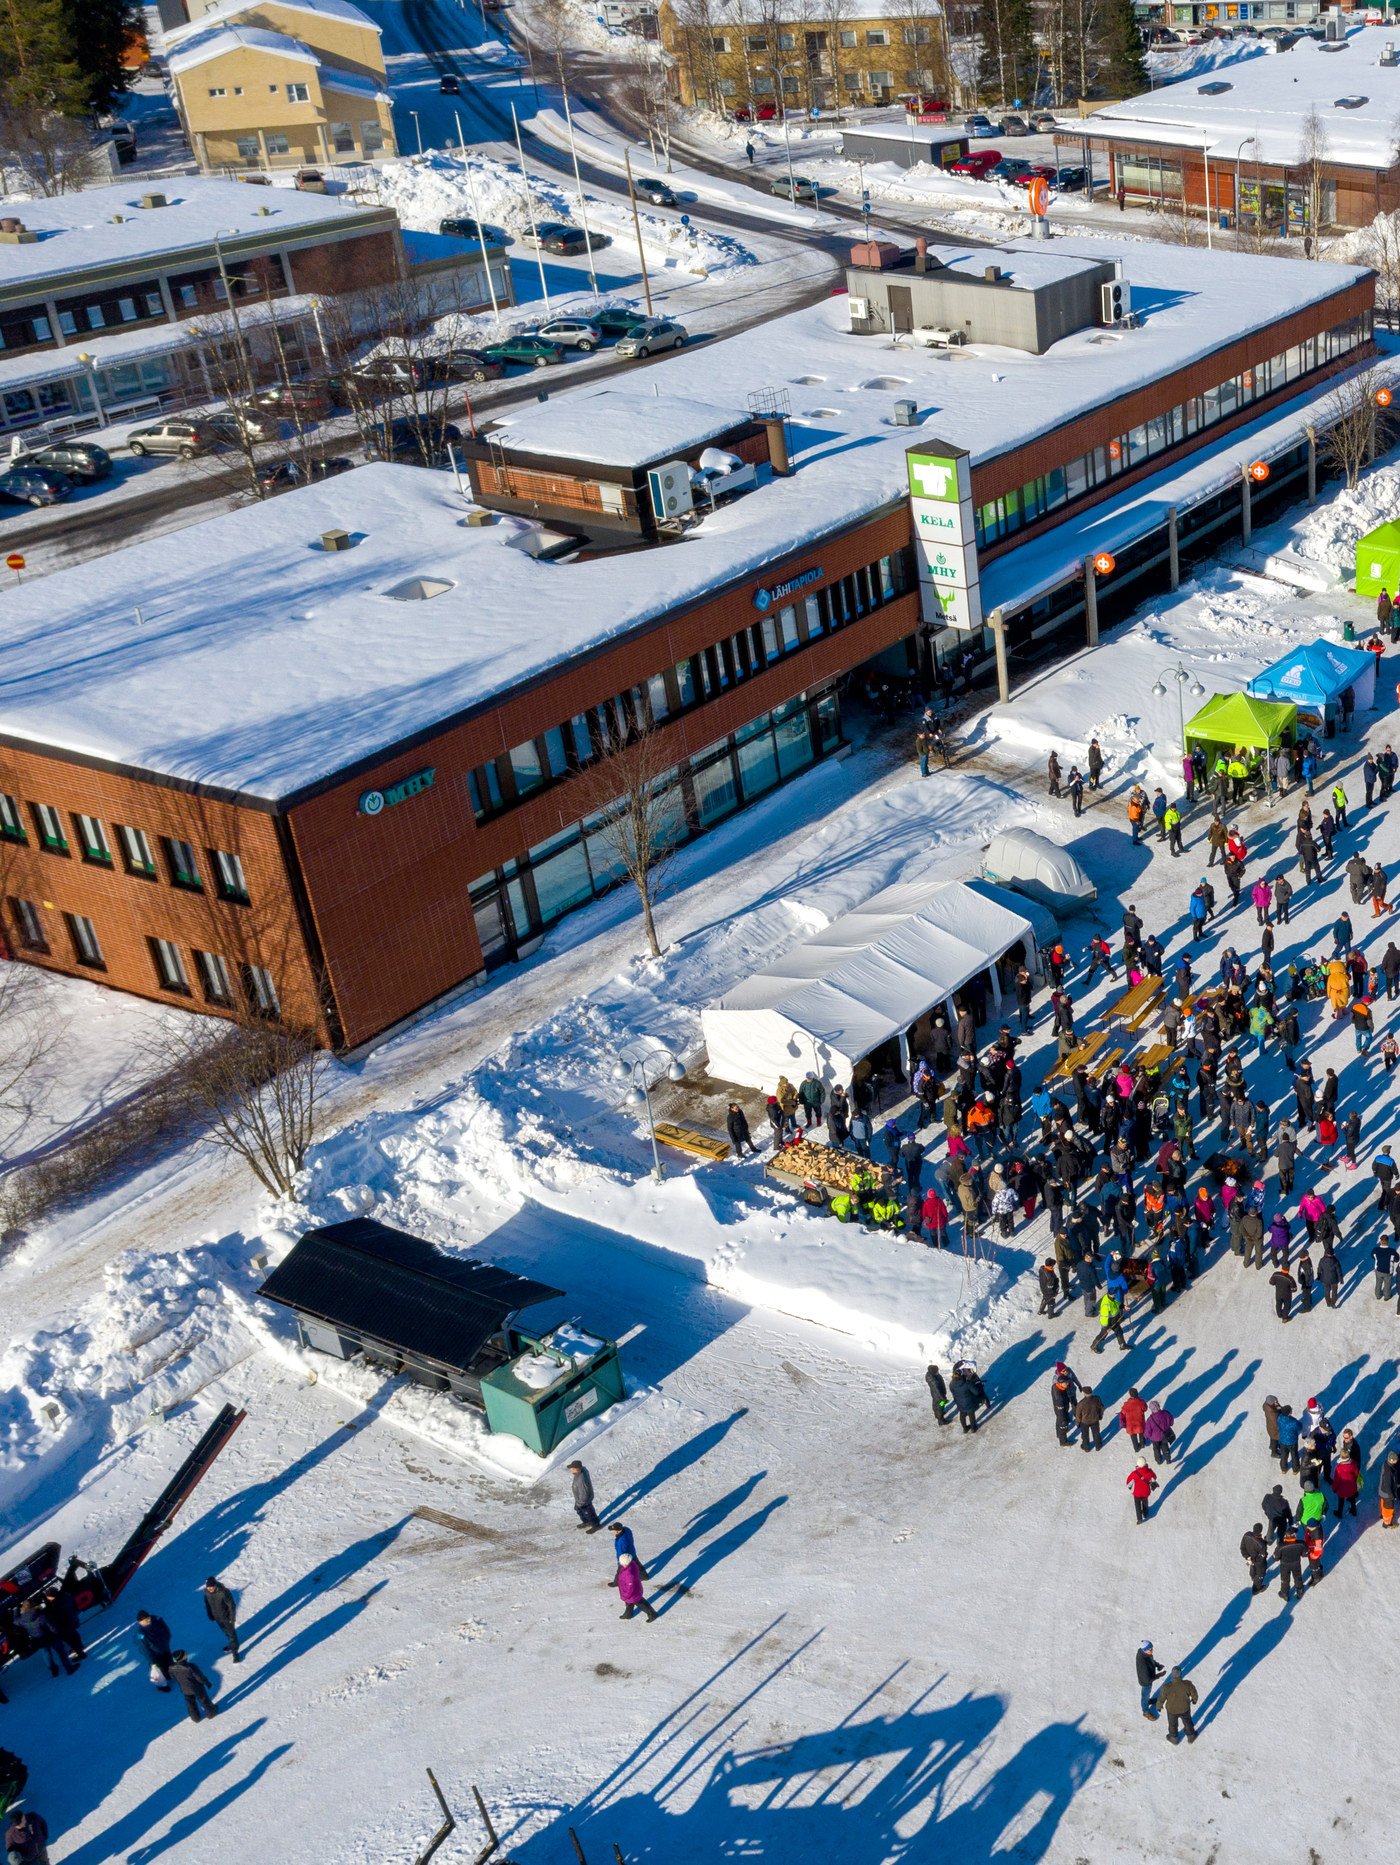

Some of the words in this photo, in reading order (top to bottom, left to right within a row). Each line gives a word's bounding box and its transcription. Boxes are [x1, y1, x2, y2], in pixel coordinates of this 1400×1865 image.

[920, 514, 955, 529] KELA
[927, 564, 957, 579] MHY
[771, 566, 824, 602] LÄHITAPIOLA
[935, 611, 958, 623] Metsä
[384, 767, 436, 806] MHY
